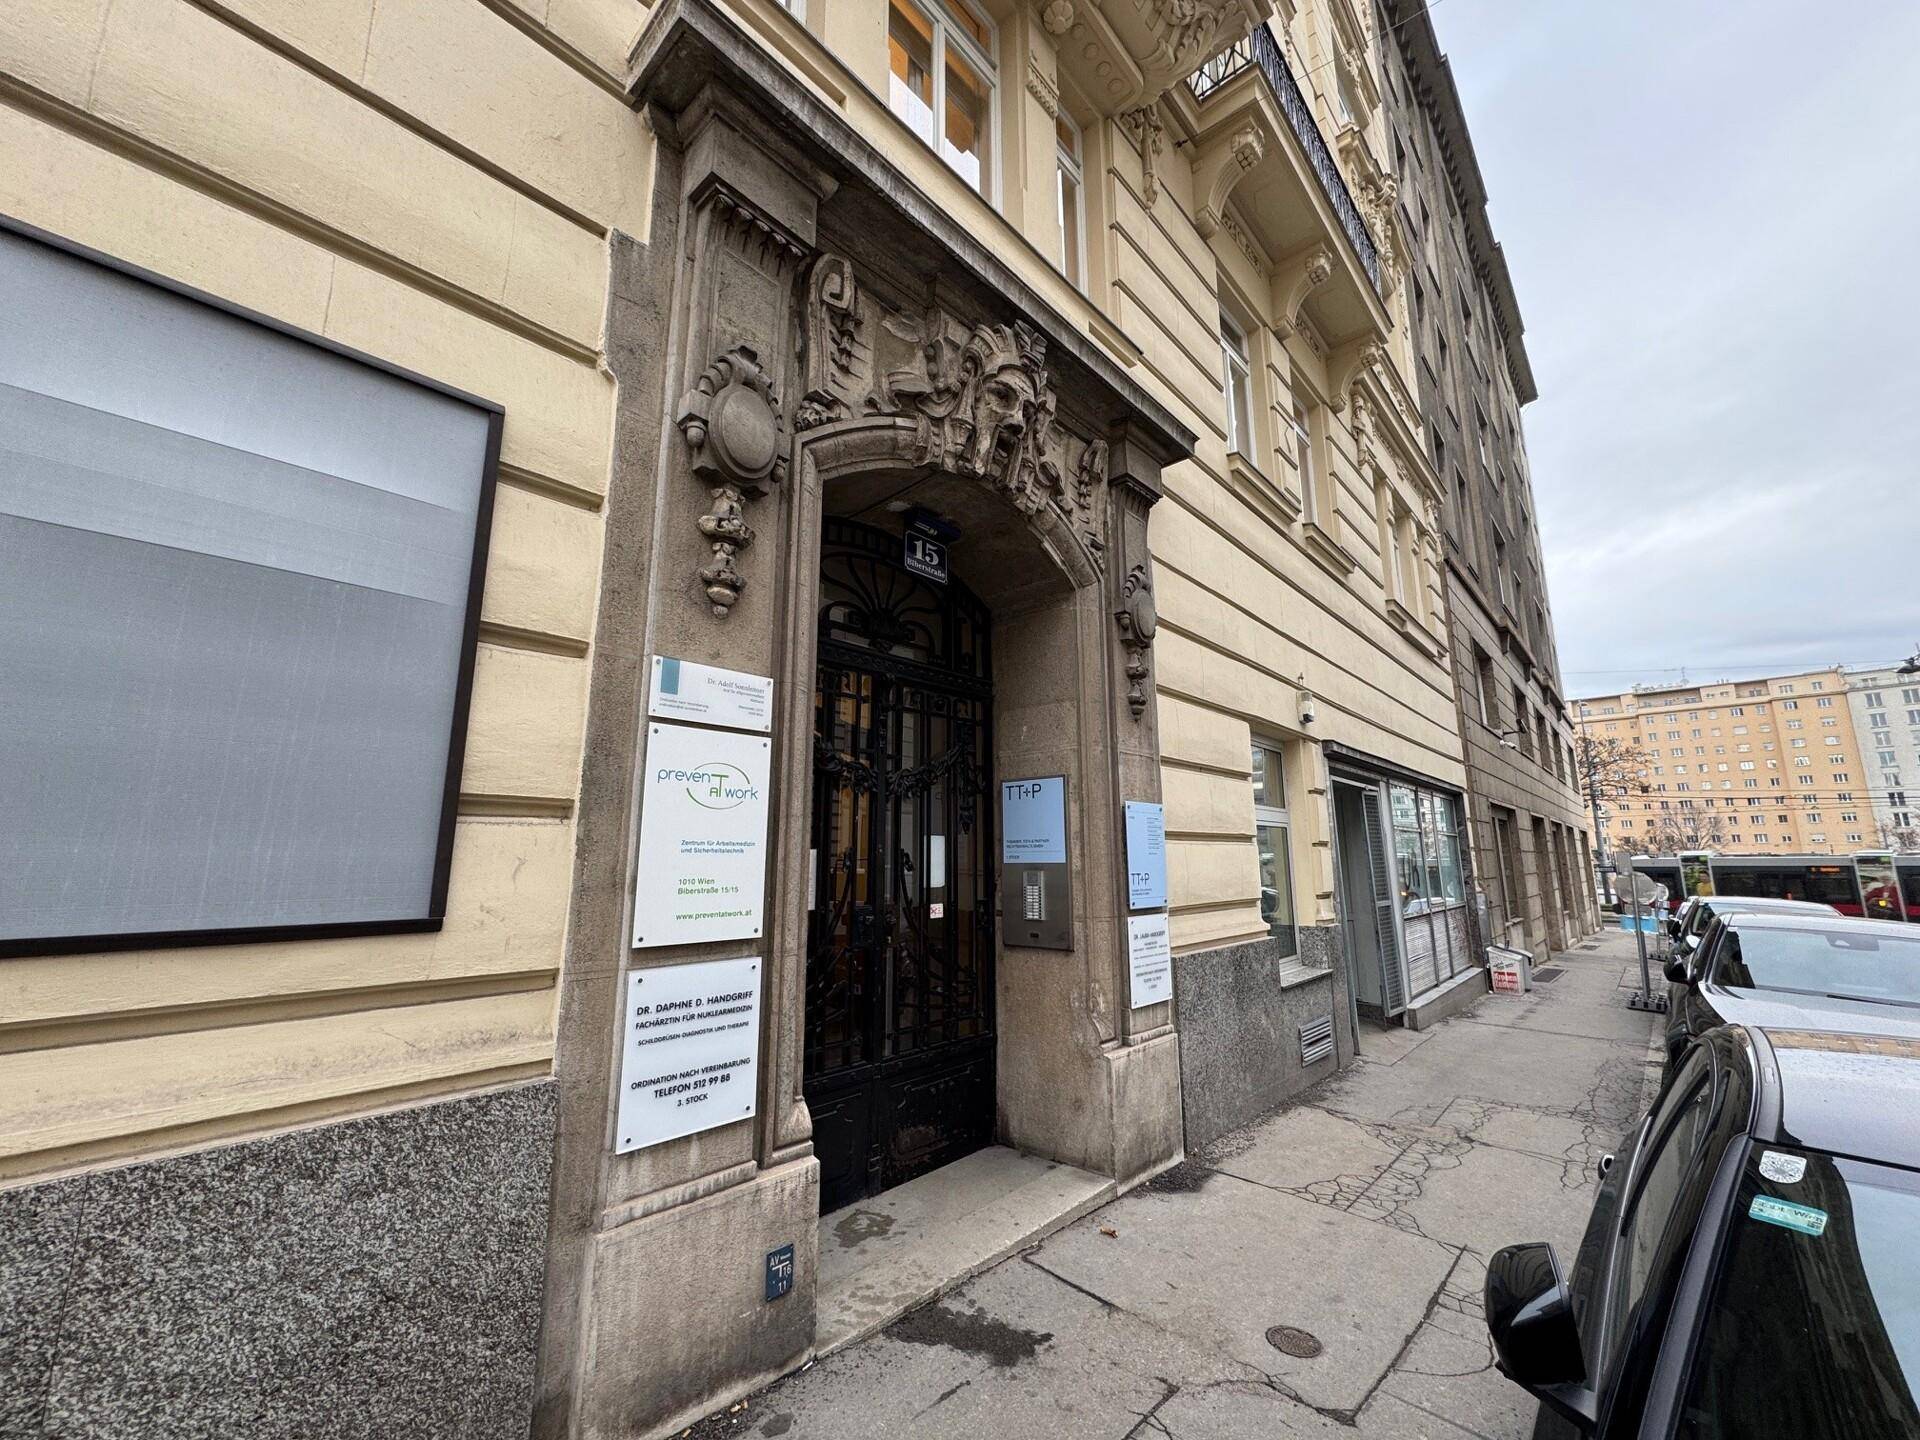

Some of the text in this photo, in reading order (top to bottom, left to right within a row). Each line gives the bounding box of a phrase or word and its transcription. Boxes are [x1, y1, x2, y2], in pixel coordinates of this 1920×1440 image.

[913, 540, 939, 566] 15
[725, 786, 758, 800] work
[1005, 783, 1042, 800] TT+P
[681, 839, 706, 847] Zentrum
[678, 878, 696, 886] 1010
[1131, 872, 1150, 886] TT+P
[677, 887, 719, 895] Biberstraße
[676, 909, 752, 921] www.preventatwork.at
[636, 990, 753, 1016] DR. DAPHNE D. HANDGRIFF
[635, 1004, 753, 1030] FACHÄRZTIN FÜR NUKLEARMEDIZIN
[631, 1057, 751, 1090] ORDINATION NACH VEREINBARUNG
[654, 1073, 731, 1099] TELEFON 512 99 88
[685, 1092, 708, 1105] STOCK
